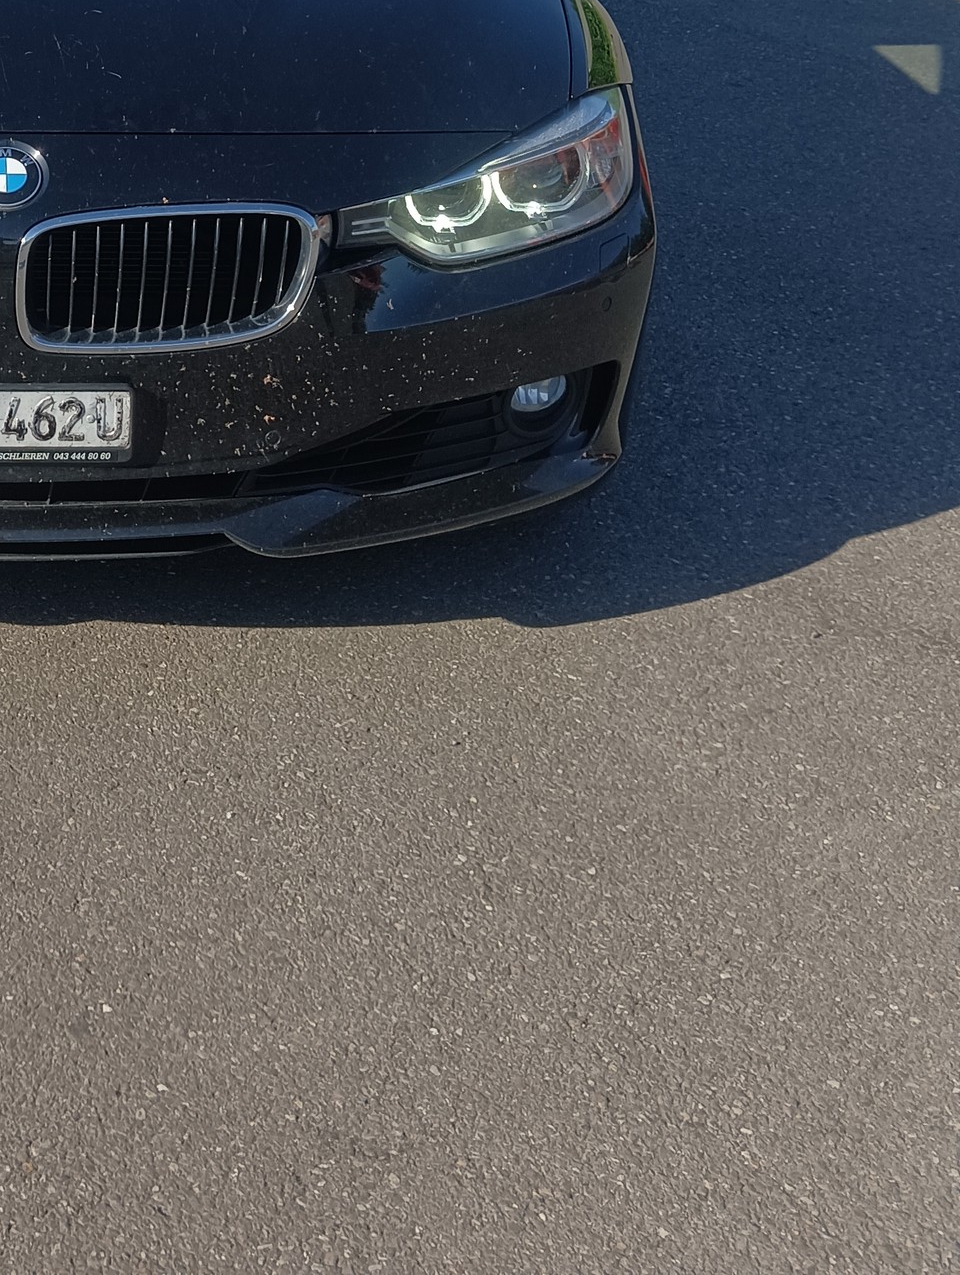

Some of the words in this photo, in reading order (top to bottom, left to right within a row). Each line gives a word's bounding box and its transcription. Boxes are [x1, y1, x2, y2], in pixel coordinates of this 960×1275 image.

[53, 452, 69, 460] 043
[70, 452, 86, 460] 444
[100, 452, 111, 460] 60
